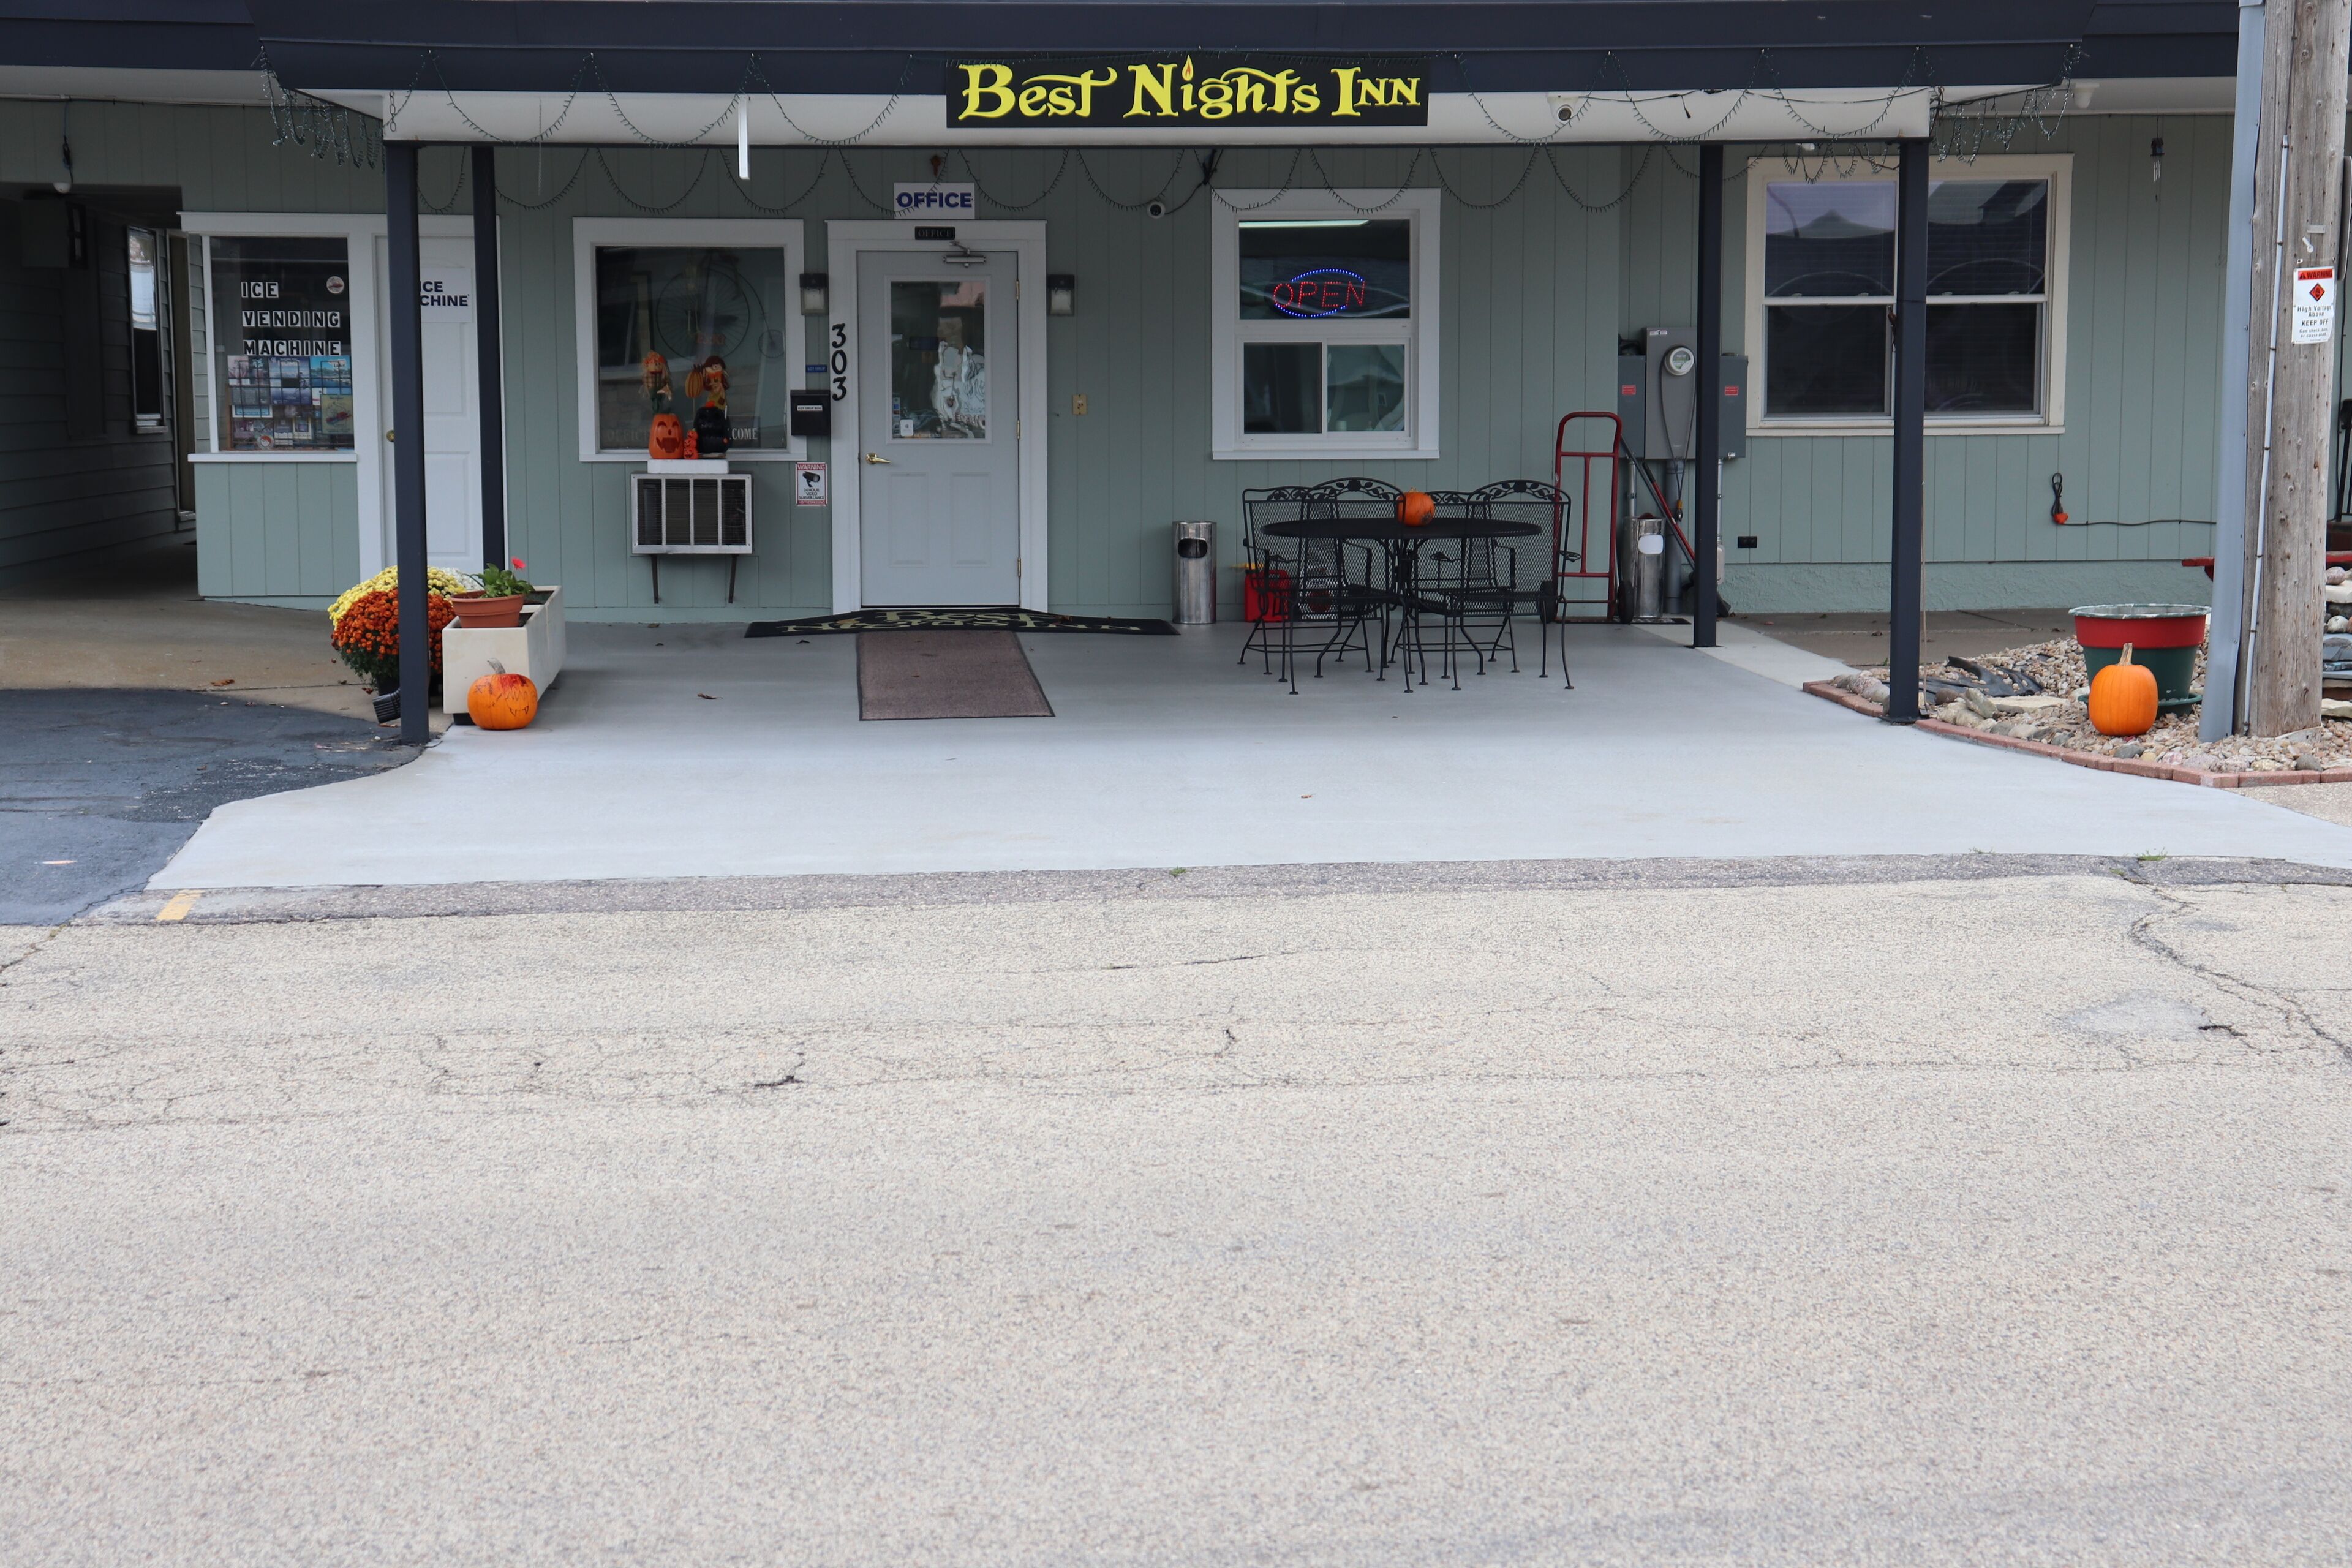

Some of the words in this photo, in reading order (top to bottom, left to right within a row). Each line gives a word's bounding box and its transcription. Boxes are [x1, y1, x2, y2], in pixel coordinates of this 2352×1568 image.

[958, 64, 1118, 121] Best
[1123, 54, 1321, 119] Nights
[897, 192, 973, 208] OFFICE
[2307, 270, 2332, 279] WARNING
[242, 282, 279, 298] ICE
[420, 281, 443, 292] CE
[1273, 281, 1366, 308] OPEN
[420, 295, 468, 306] CHINE
[243, 311, 340, 327] VENDING
[244, 340, 341, 356] MACHINE
[831, 323, 847, 401] 303
[730, 428, 758, 440] COME
